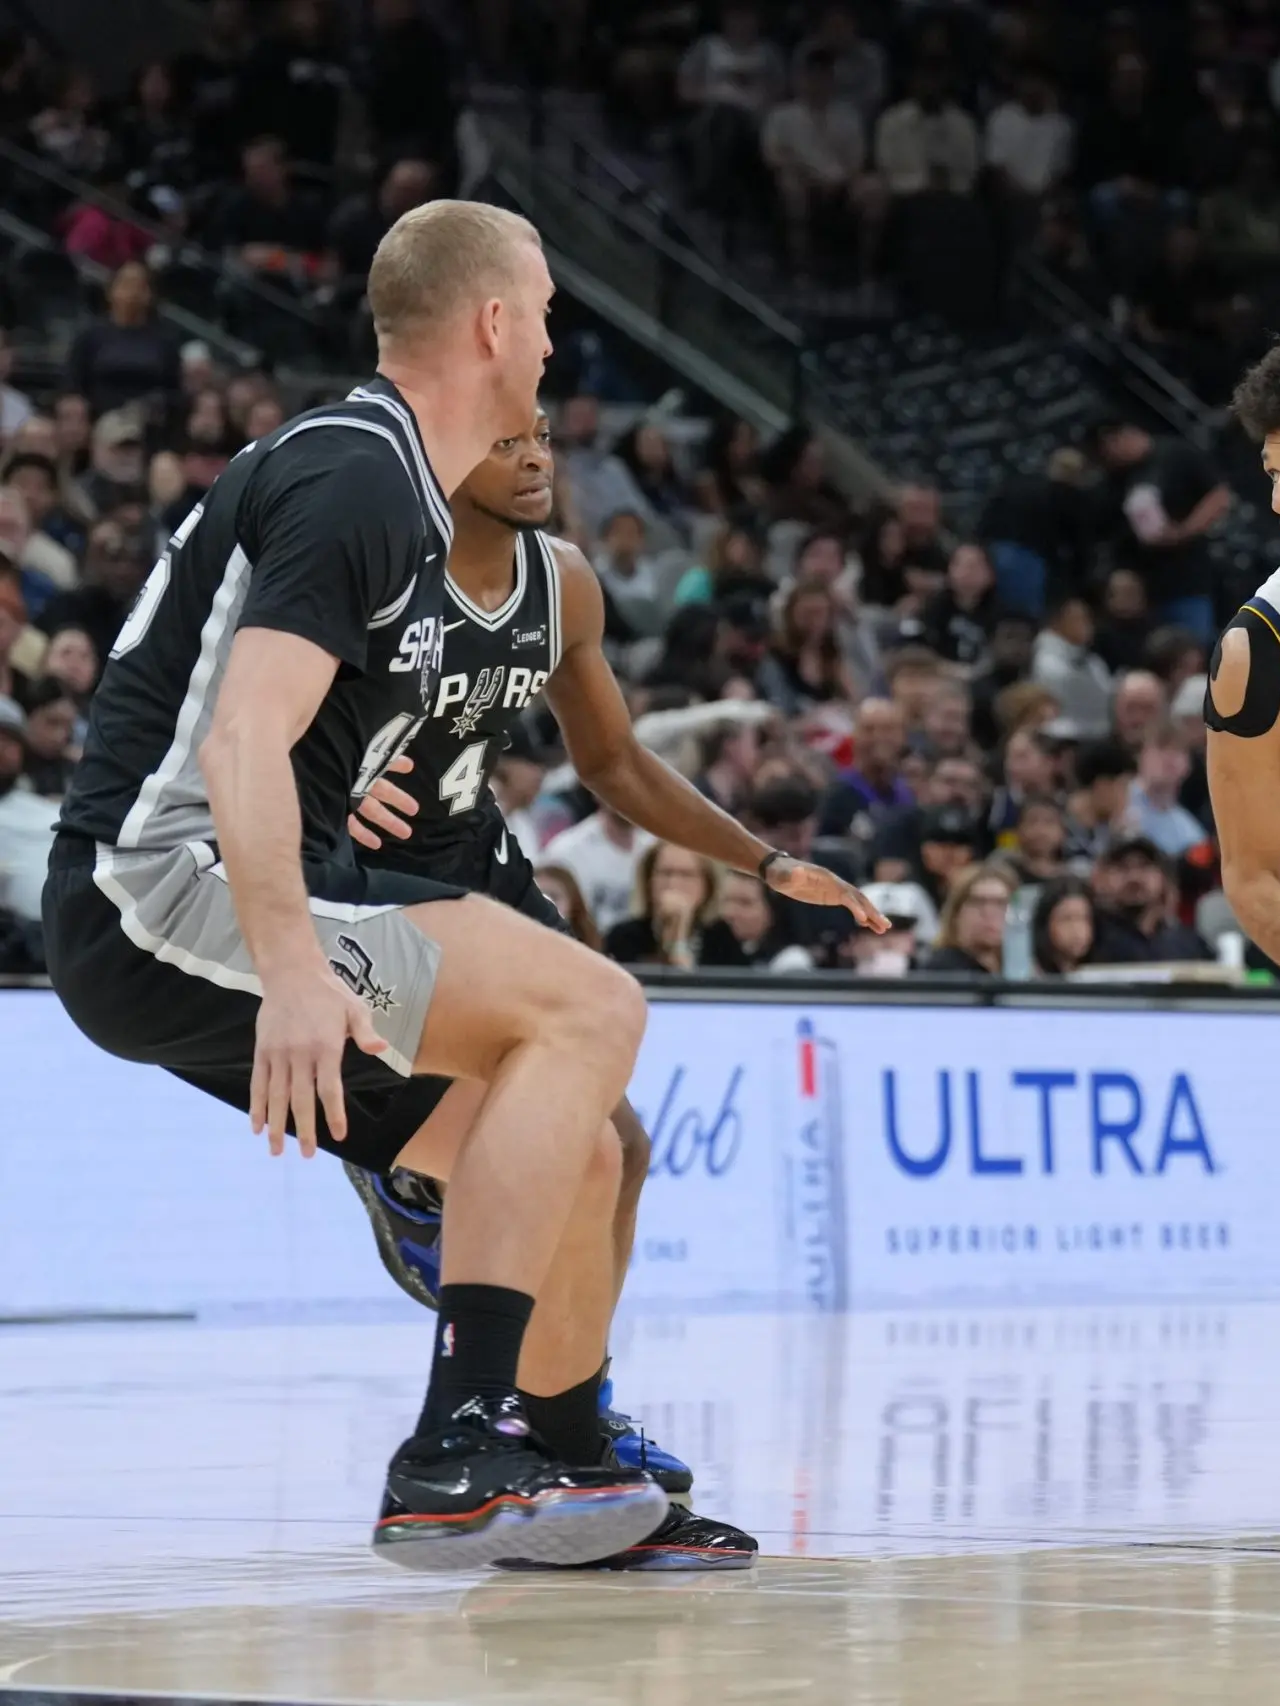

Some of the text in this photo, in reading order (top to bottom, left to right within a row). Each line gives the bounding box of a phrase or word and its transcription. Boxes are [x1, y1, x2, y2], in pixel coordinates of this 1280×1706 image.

[516, 630, 542, 643] LEDGER
[439, 739, 489, 817] 4
[634, 1064, 743, 1177] lob
[882, 1068, 1217, 1178] ULTRA
[885, 1221, 1231, 1254] SUPERIOR LIGHT BEER
